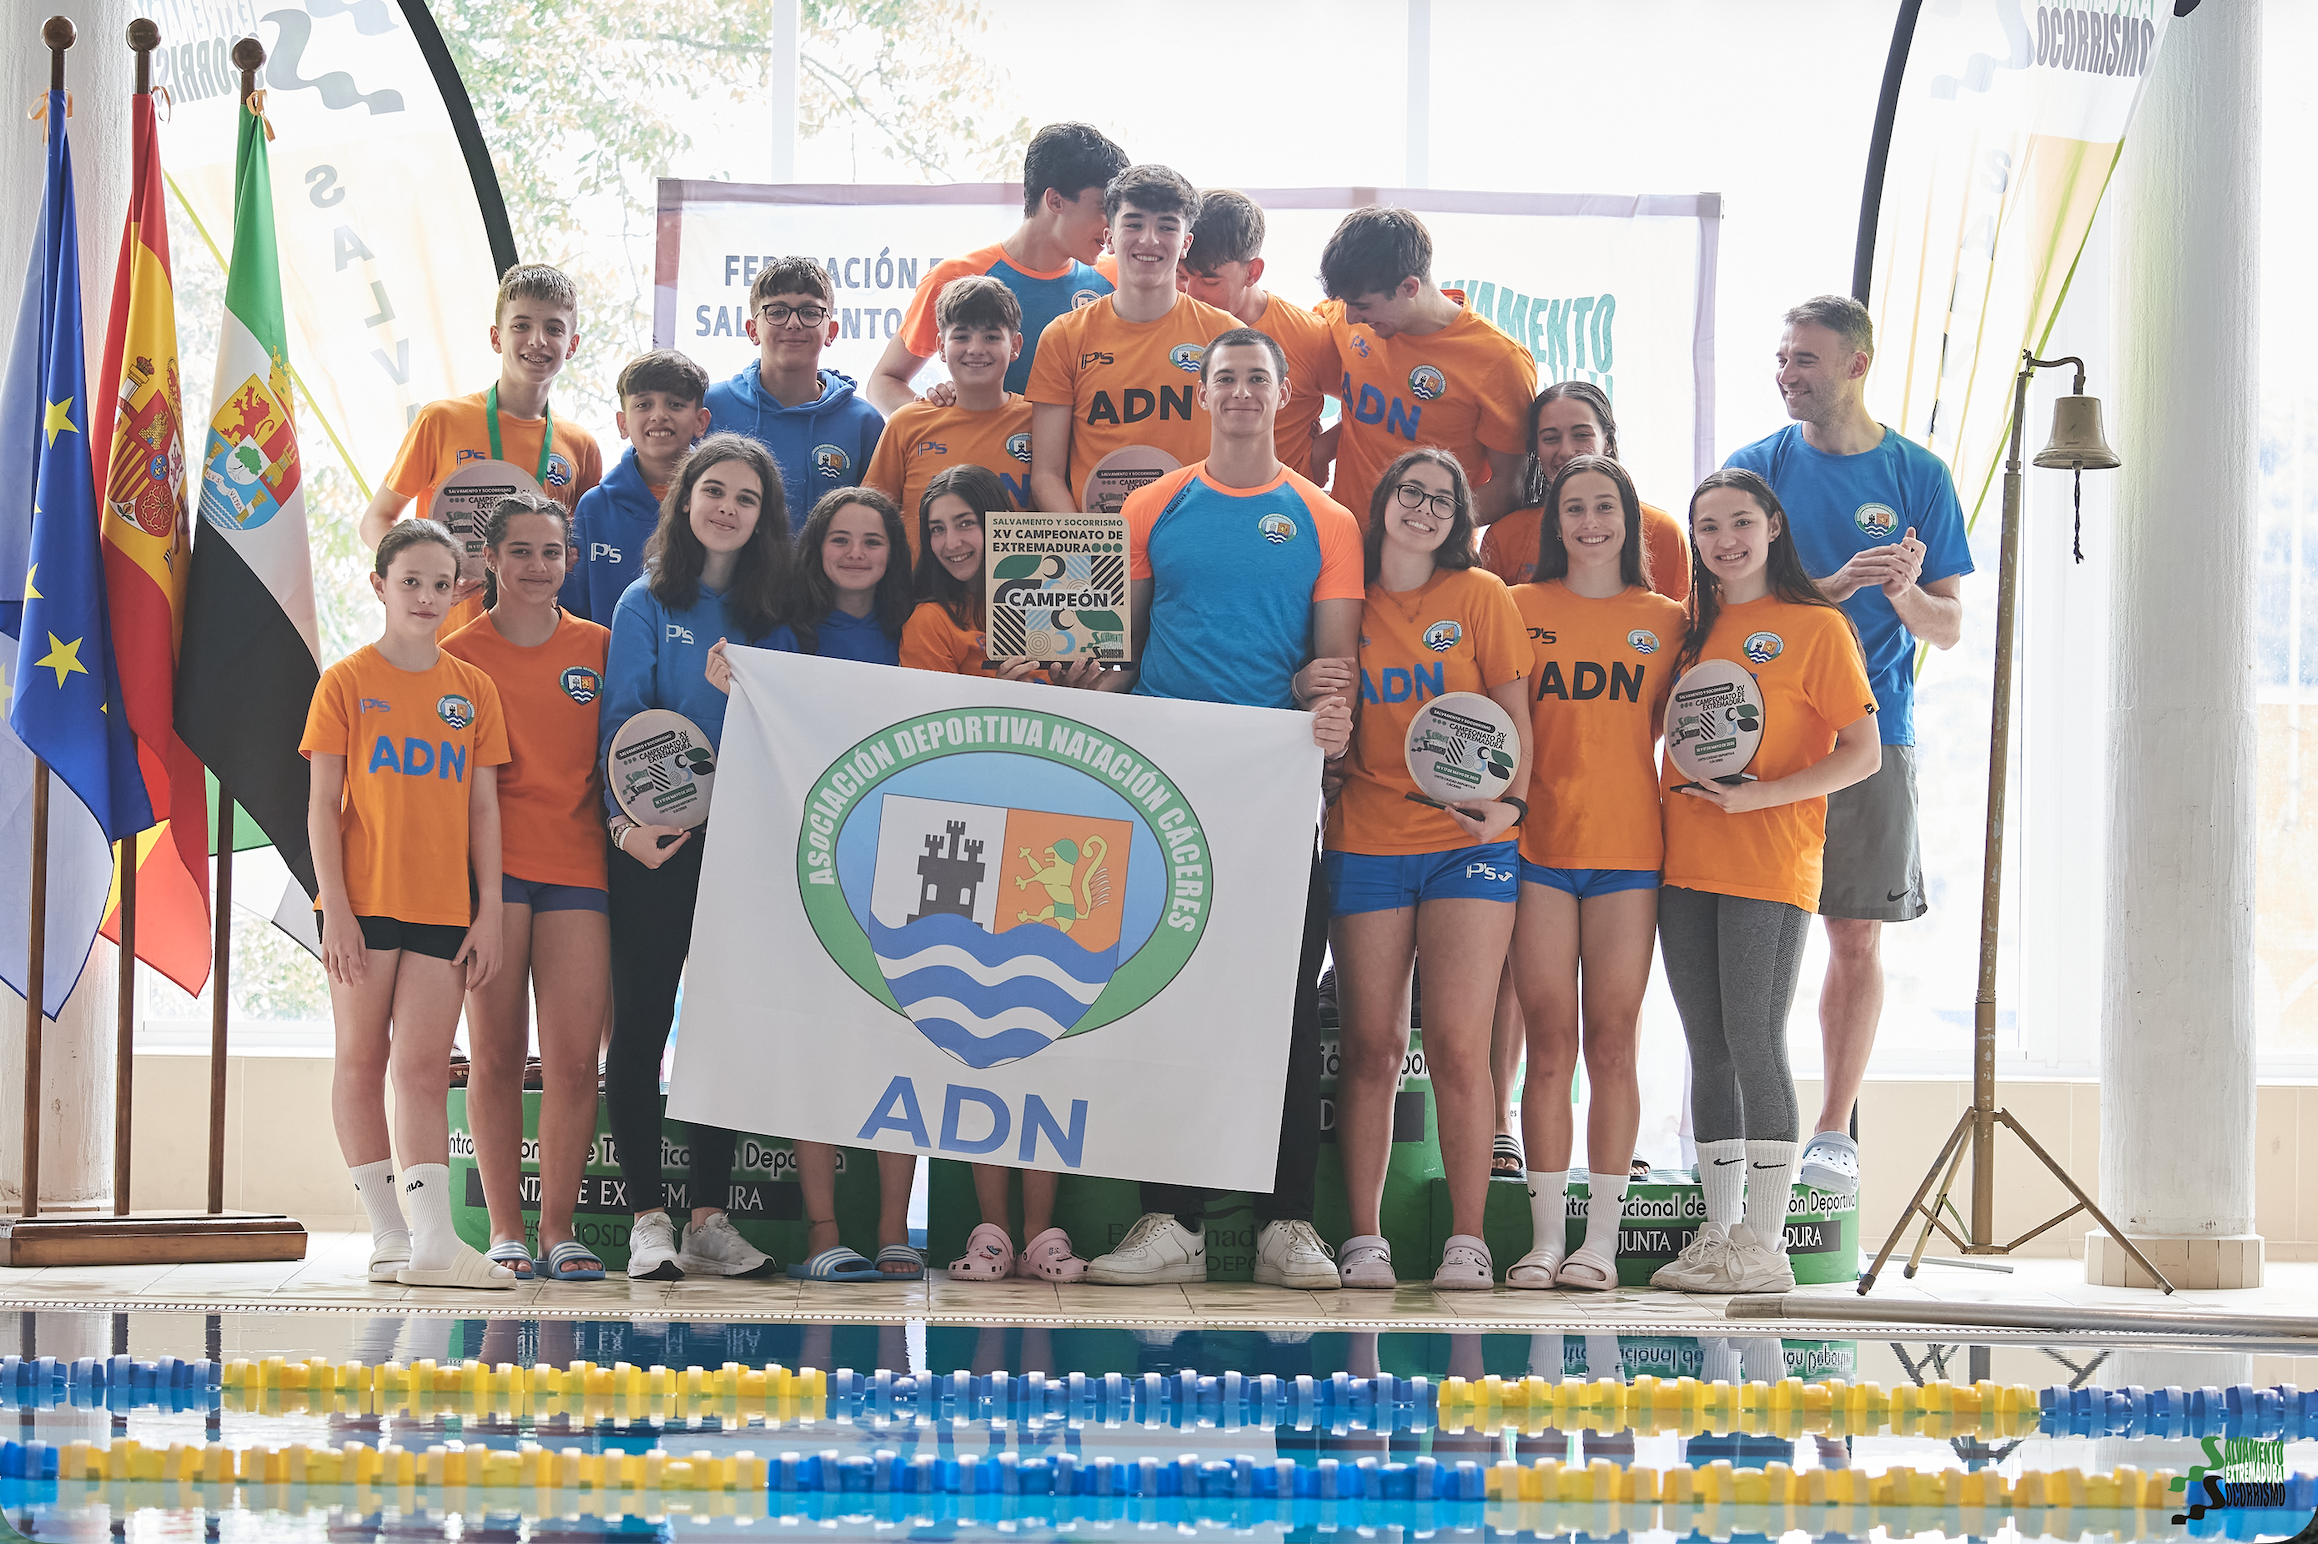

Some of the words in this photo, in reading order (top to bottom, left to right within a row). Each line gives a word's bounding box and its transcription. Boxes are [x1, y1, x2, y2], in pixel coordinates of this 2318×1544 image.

[725, 246, 917, 289] FEACIÓN
[1087, 385, 1193, 425] ADN
[1342, 371, 1422, 441] ADN
[992, 518, 1054, 527] SALVAMENTO
[1064, 519, 1123, 527] SOCORRISMO
[993, 529, 1012, 539] XV
[1015, 529, 1104, 540] CAMPEONATO
[1108, 530, 1123, 540] DE
[993, 542, 1092, 553] EXTREMADURA
[1009, 588, 1108, 608] CAMPEÓN
[1536, 661, 1645, 703] ADN
[1695, 692, 1737, 706] CAMPEONATO
[1449, 723, 1496, 741] CAMPEONATO
[368, 735, 466, 783] ADN
[808, 739, 897, 886] ASOCIACIÓN
[894, 714, 1043, 761] DEPORTIVA
[1048, 723, 1173, 814] NATACIÓN
[1156, 807, 1203, 933] CÁCERES
[857, 1075, 1089, 1169] ADN
[1619, 1231, 1672, 1254] JUNTA
